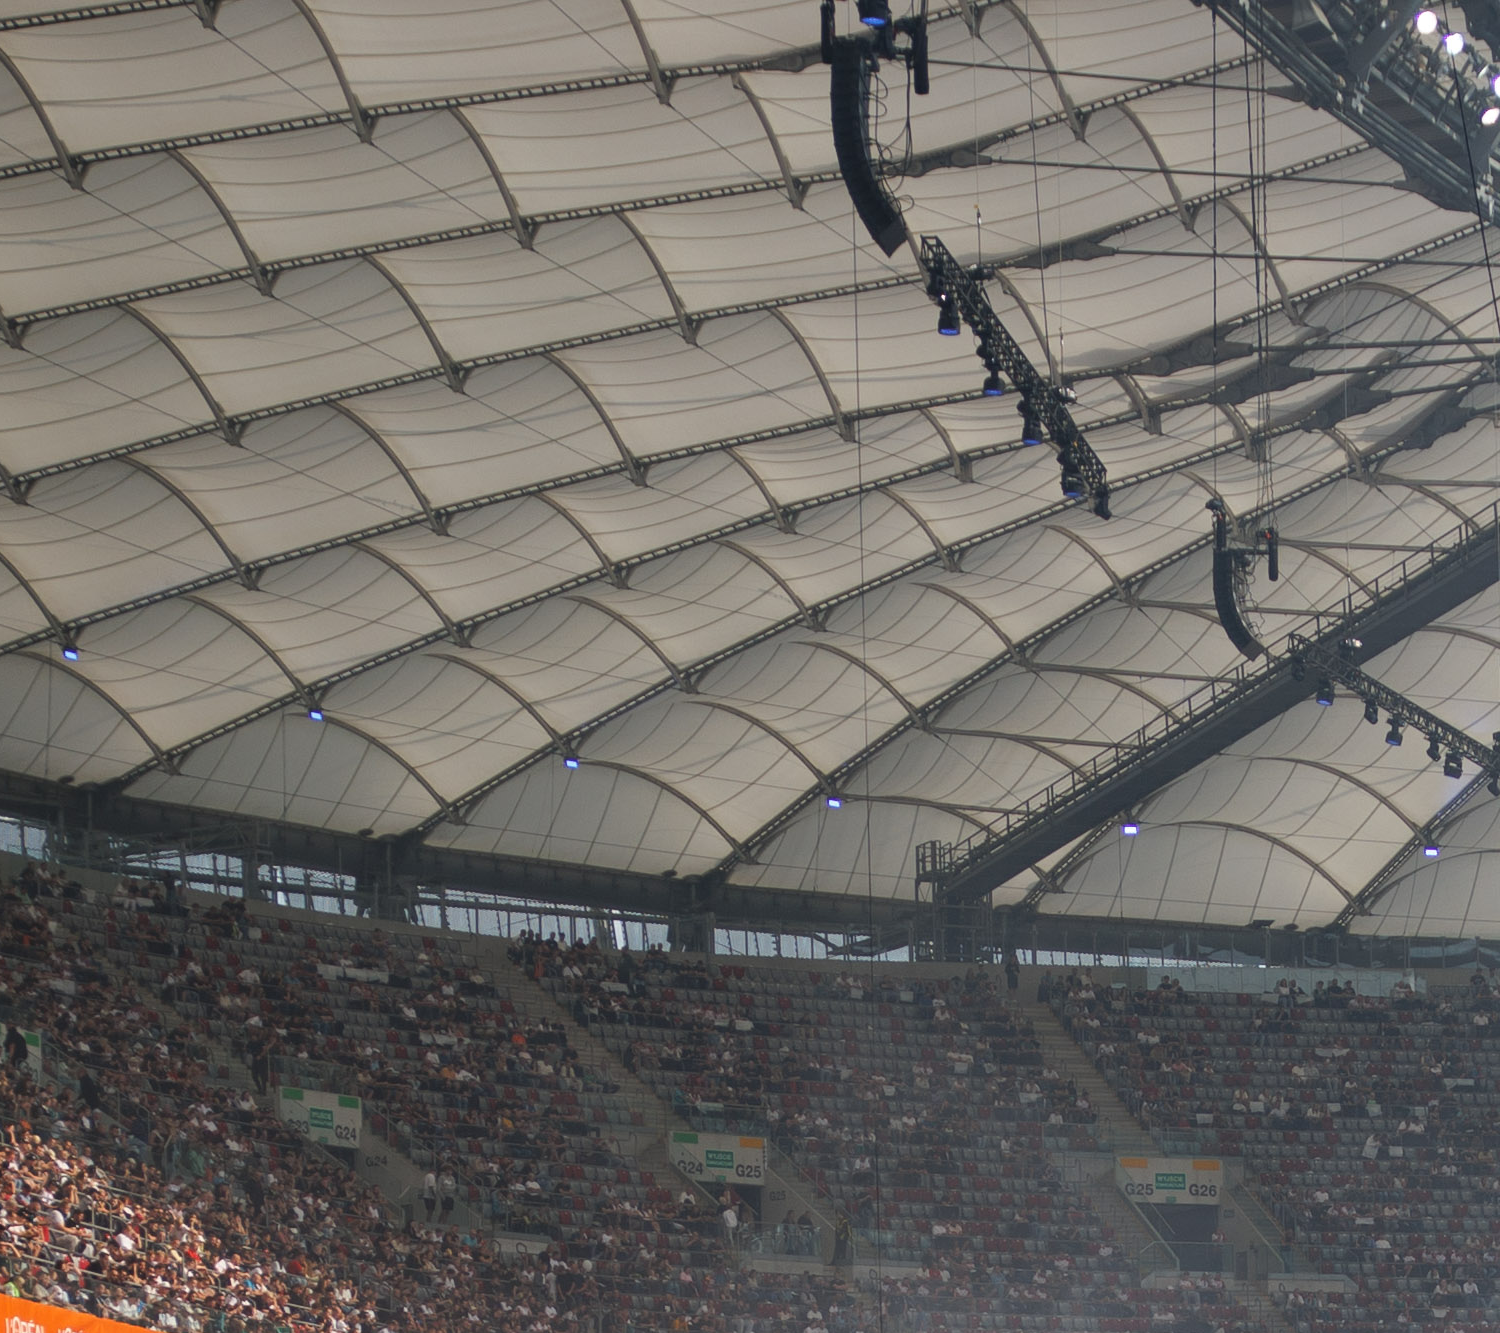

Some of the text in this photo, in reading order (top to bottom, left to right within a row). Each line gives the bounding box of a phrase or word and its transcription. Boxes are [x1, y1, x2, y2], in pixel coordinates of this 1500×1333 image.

[334, 1125, 357, 1142] G24
[736, 1164, 761, 1179] G25
[1125, 1183, 1217, 1197] G25 G26
